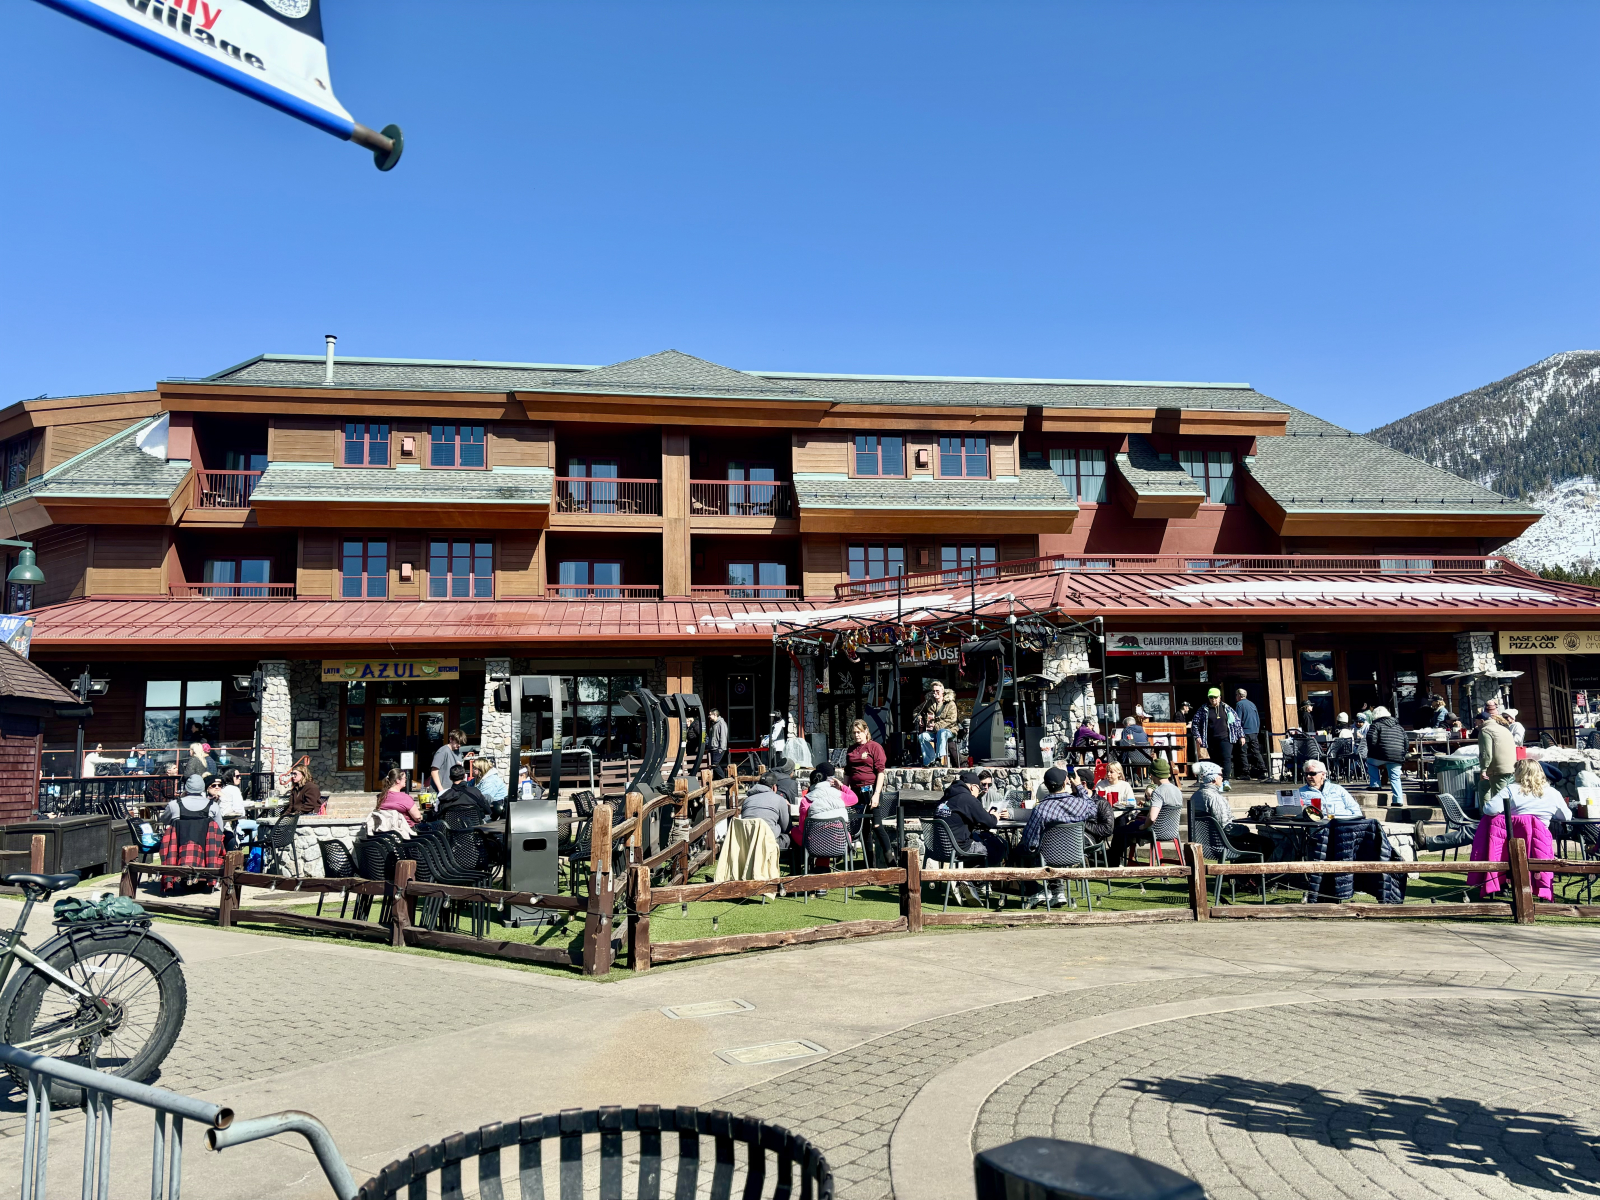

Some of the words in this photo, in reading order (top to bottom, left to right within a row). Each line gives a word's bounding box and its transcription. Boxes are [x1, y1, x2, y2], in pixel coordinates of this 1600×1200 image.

[1143, 637, 1188, 646] CALIFORNIA
[1192, 636, 1224, 646] BURGER
[1227, 636, 1241, 646] CO.
[1534, 634, 1560, 642] CAMP
[1509, 642, 1538, 650] PIZZA
[1539, 641, 1557, 649] CO.
[360, 663, 420, 678] AZUL
